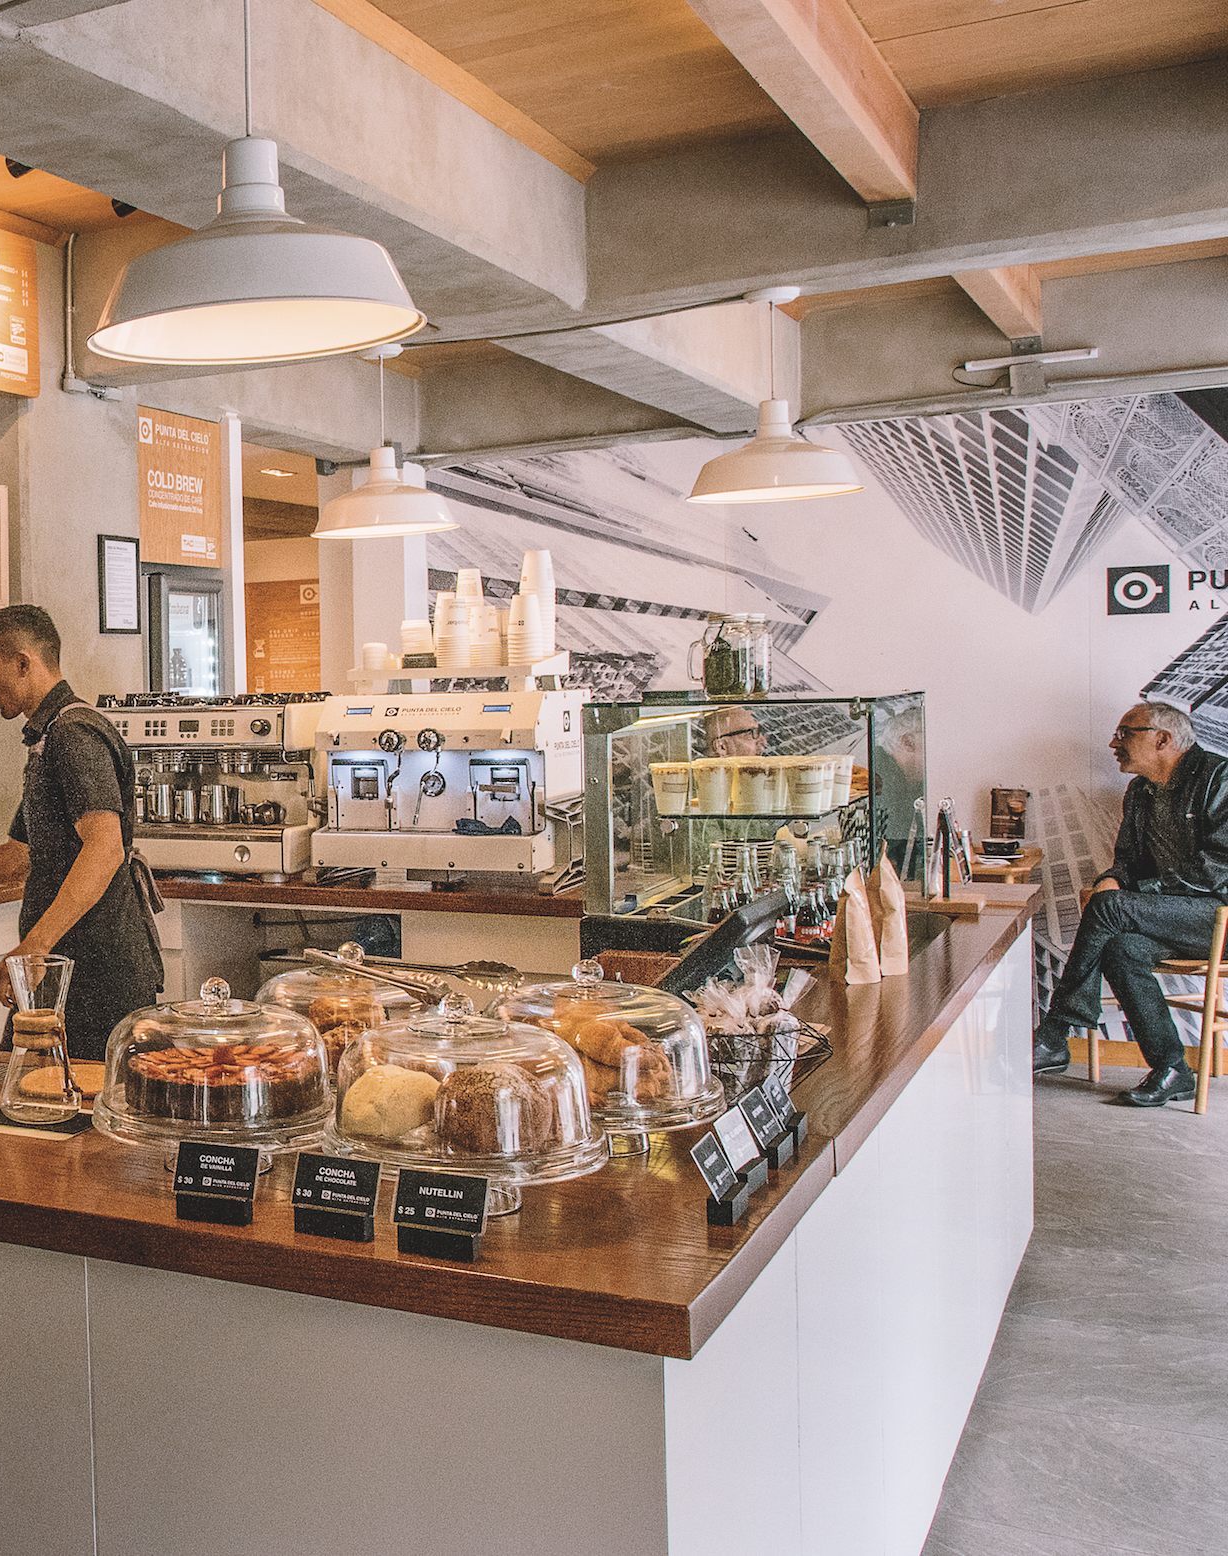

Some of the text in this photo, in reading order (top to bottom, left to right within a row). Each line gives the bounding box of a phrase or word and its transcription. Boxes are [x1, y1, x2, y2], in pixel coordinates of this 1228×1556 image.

[155, 424, 209, 445] PUNTA DEL CIELO
[148, 470, 203, 494] COLD BREW
[199, 1154, 236, 1166] CONCHA
[209, 1164, 232, 1172] VAINILLA
[318, 1166, 356, 1180] CONCHA
[178, 1175, 194, 1184] $ 30
[324, 1176, 358, 1186] CHOCOLATE
[296, 1188, 312, 1198] $ 30
[418, 1186, 464, 1200] NUTELLIN
[398, 1206, 416, 1216] $ 25
